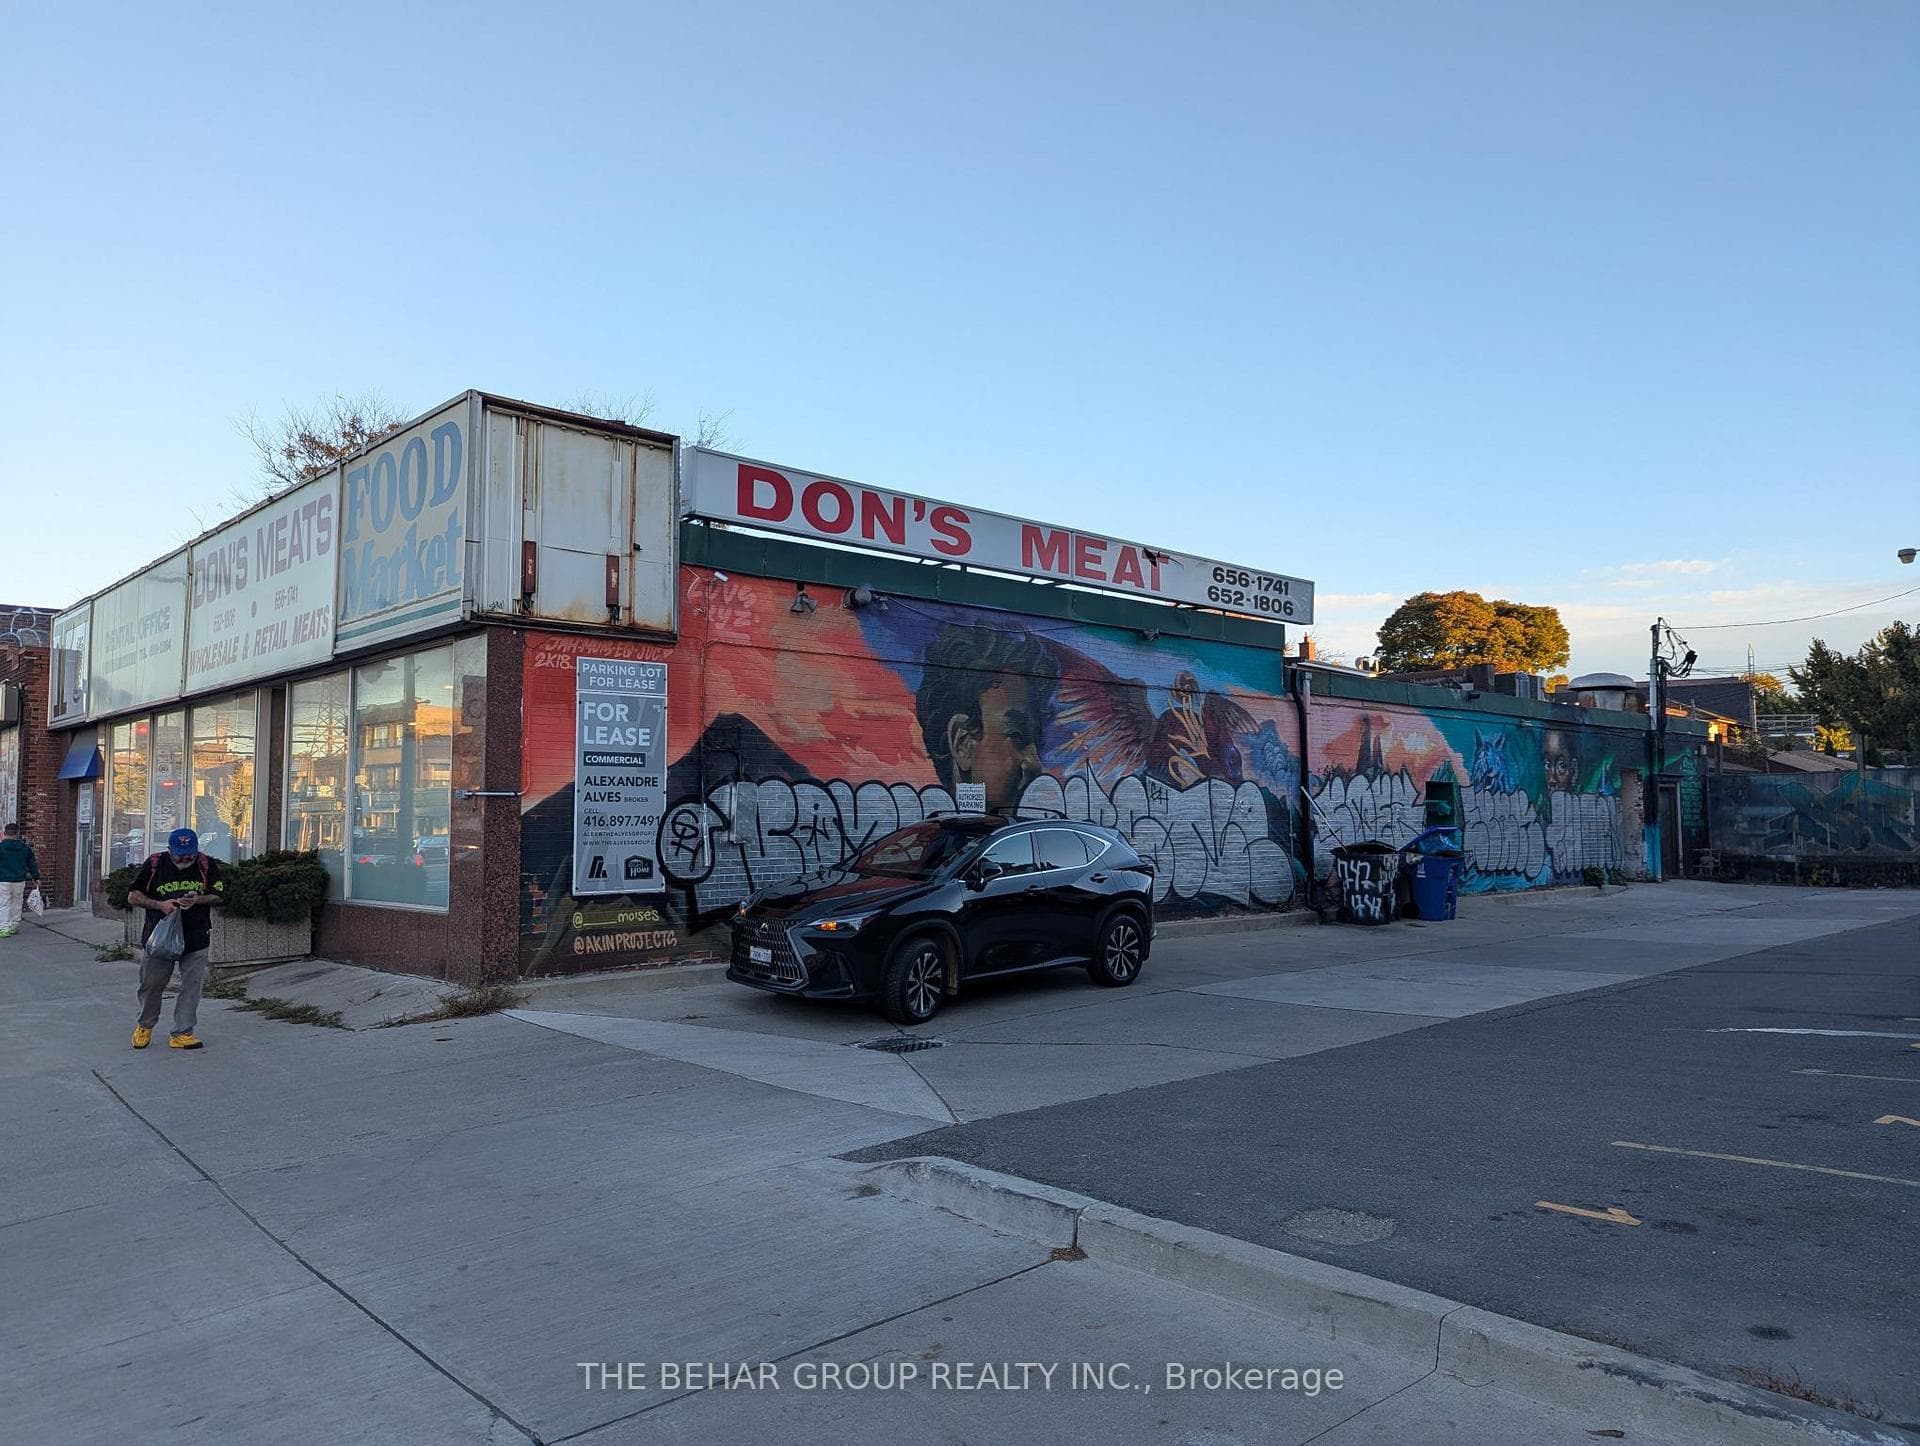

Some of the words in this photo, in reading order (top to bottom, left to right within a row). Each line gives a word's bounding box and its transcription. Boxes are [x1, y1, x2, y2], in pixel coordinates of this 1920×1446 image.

[345, 421, 463, 543] FOOD
[737, 463, 972, 556] DON'S
[1021, 523, 1169, 592] MEAT
[192, 536, 249, 610] DON'S
[256, 493, 332, 583] MEATS
[340, 506, 463, 621] Market
[1212, 566, 1289, 596] 656-1741
[1207, 585, 1294, 616] 652-1806
[189, 635, 240, 677] WHOLESALE
[242, 632, 250, 661] &
[253, 619, 288, 657] RETAIL
[292, 604, 330, 646] MEATS
[582, 663, 636, 676] PARKING
[640, 667, 662, 678] LOT
[589, 676, 614, 687] FOR
[618, 678, 656, 690] LEASE
[583, 701, 629, 722] FOR
[583, 725, 651, 747] LEASE
[585, 755, 643, 765] COMMERCIAL
[584, 775, 659, 787] ALEXANDRE
[583, 791, 622, 803] ALVES
[958, 801, 984, 809] PARKING
[583, 815, 660, 827] 416.897.7491
